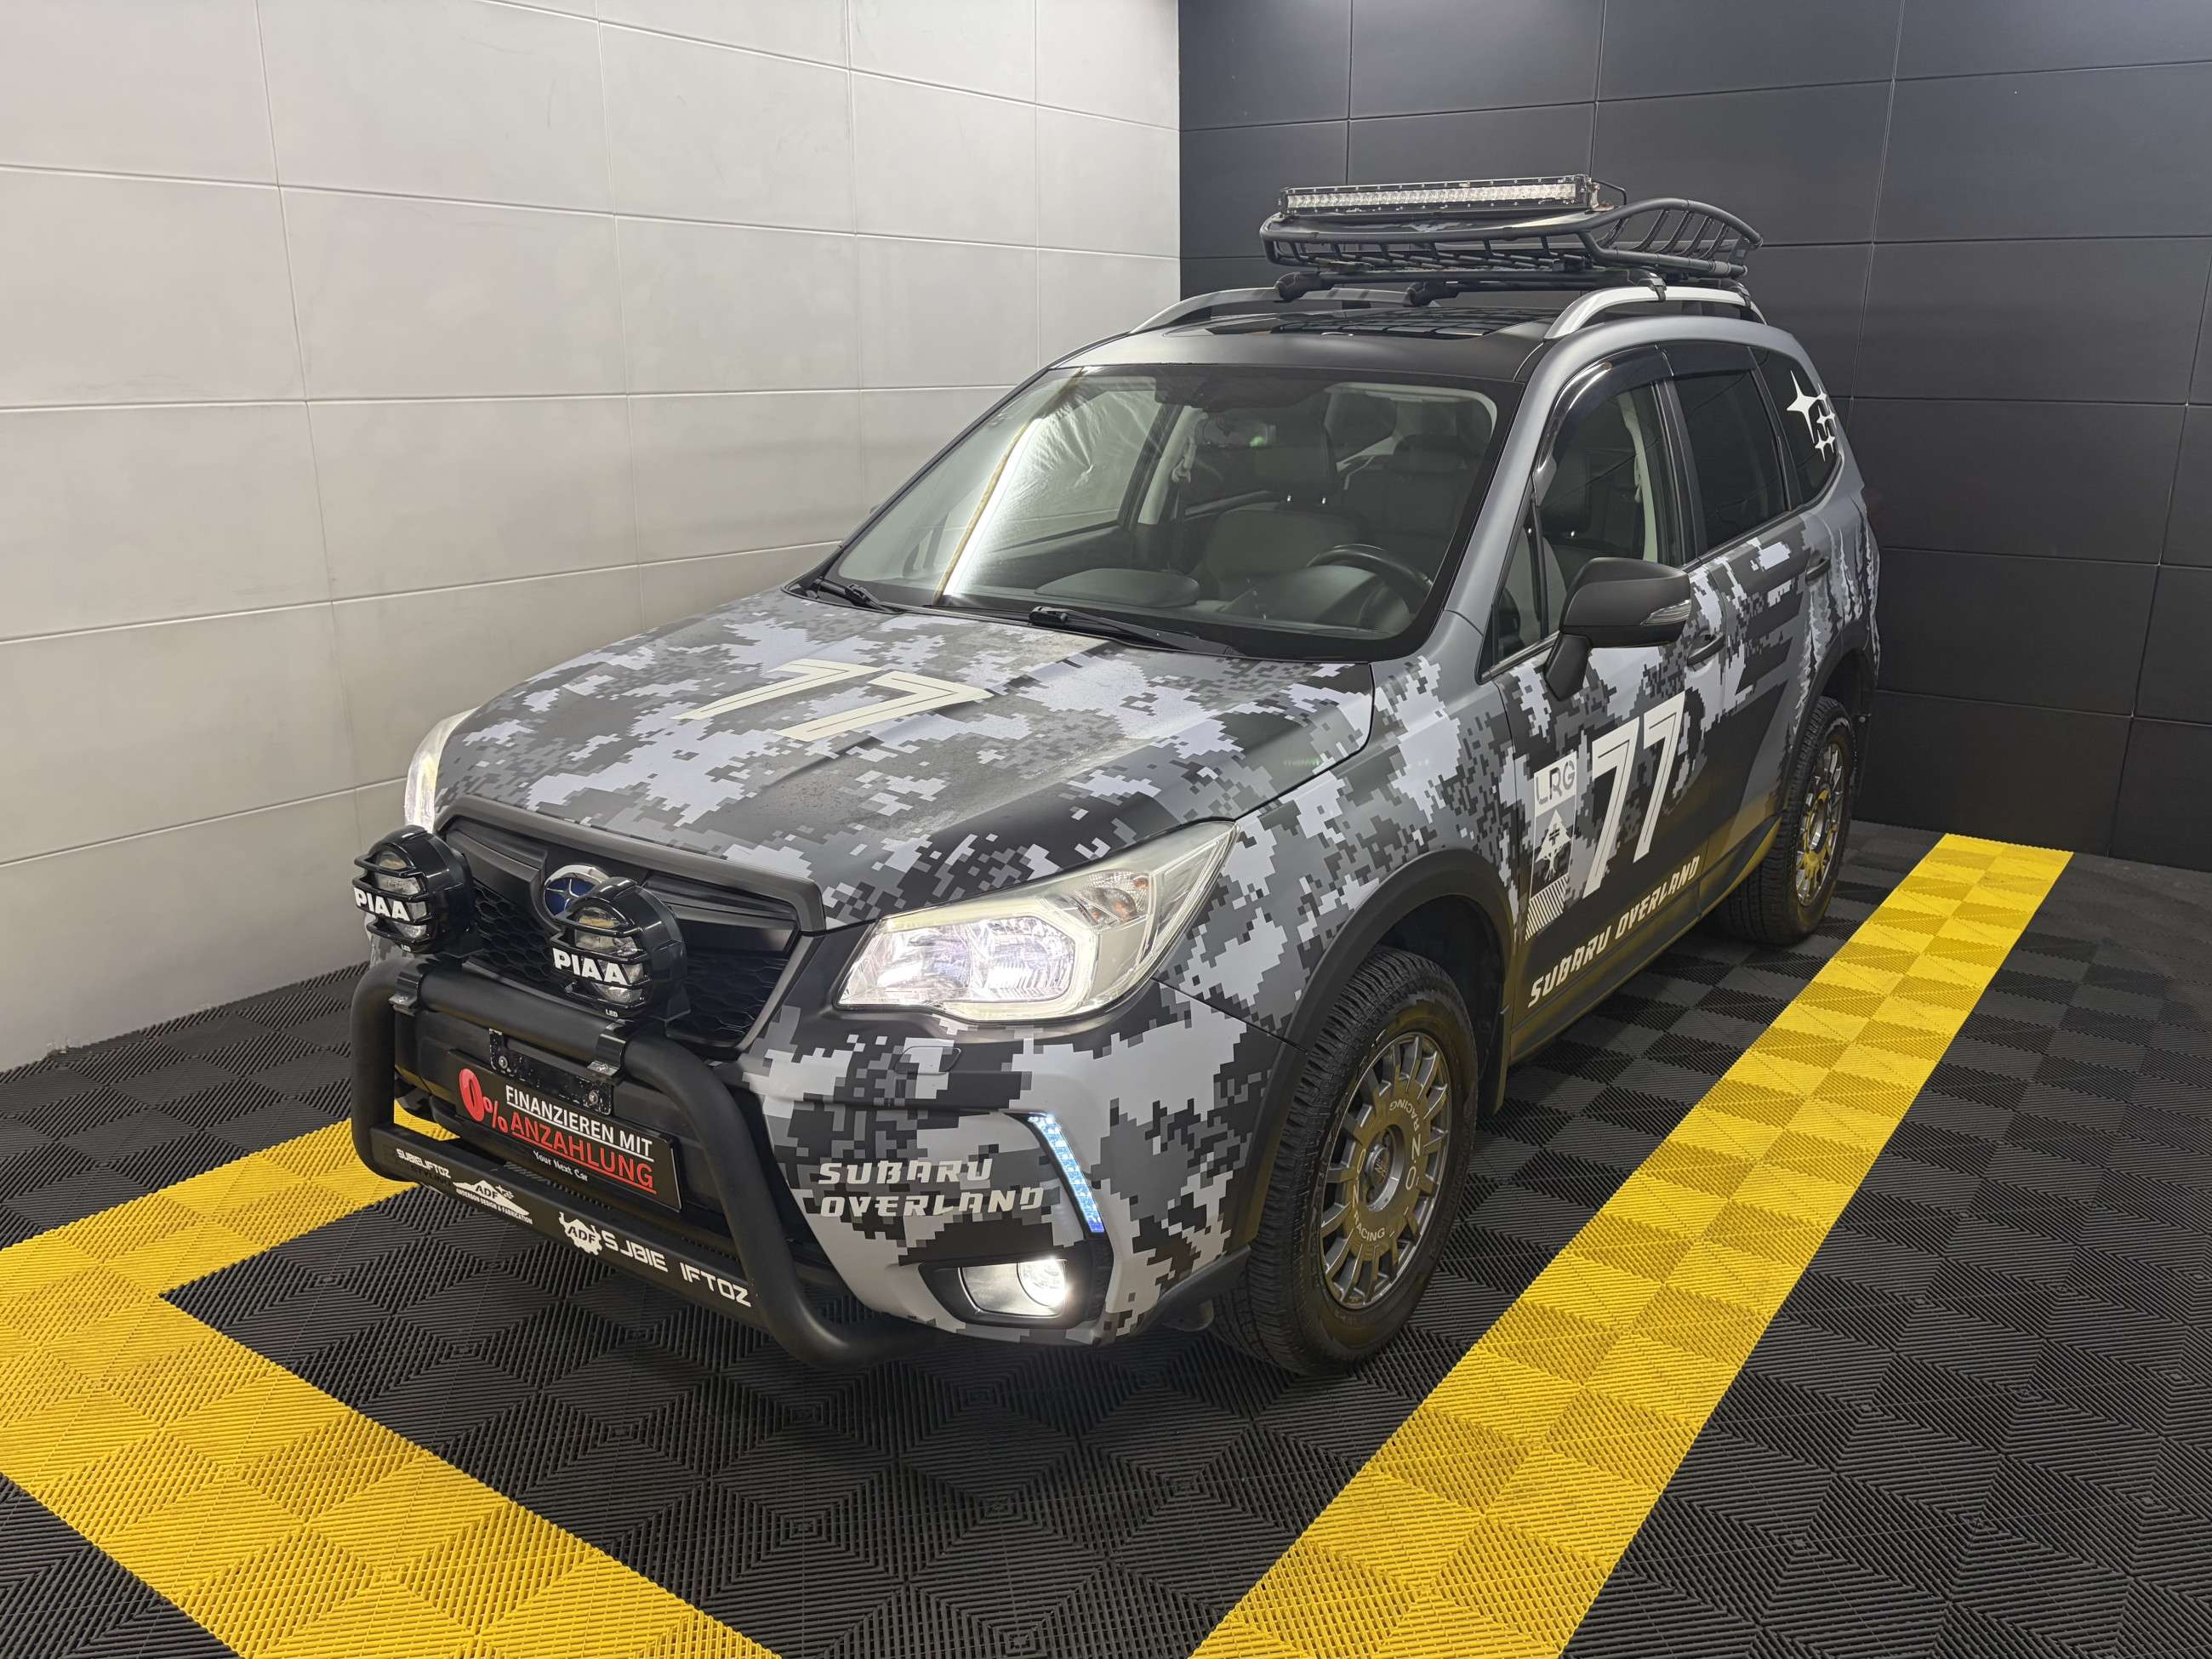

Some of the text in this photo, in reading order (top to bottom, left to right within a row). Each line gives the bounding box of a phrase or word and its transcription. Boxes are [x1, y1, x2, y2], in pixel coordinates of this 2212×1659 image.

[670, 658, 994, 742] 77
[1536, 760, 1576, 805] LRG
[1582, 690, 1685, 899] 77
[353, 887, 410, 921] PIAA
[1528, 855, 1700, 1008] SUBARU OVERLAND
[552, 947, 628, 986] PIAA
[505, 1085, 653, 1157] FINANZIEREN MIT
[1389, 1098, 1420, 1132] RACING
[511, 1112, 653, 1189] ANZAHLUNG
[533, 1150, 589, 1182] Your Next Car
[818, 1158, 993, 1185] SUBARU
[476, 1185, 499, 1200] ADF
[820, 1187, 1044, 1217] OVERLAND
[567, 1226, 596, 1244] ADF
[1353, 1210, 1386, 1241] RACING
